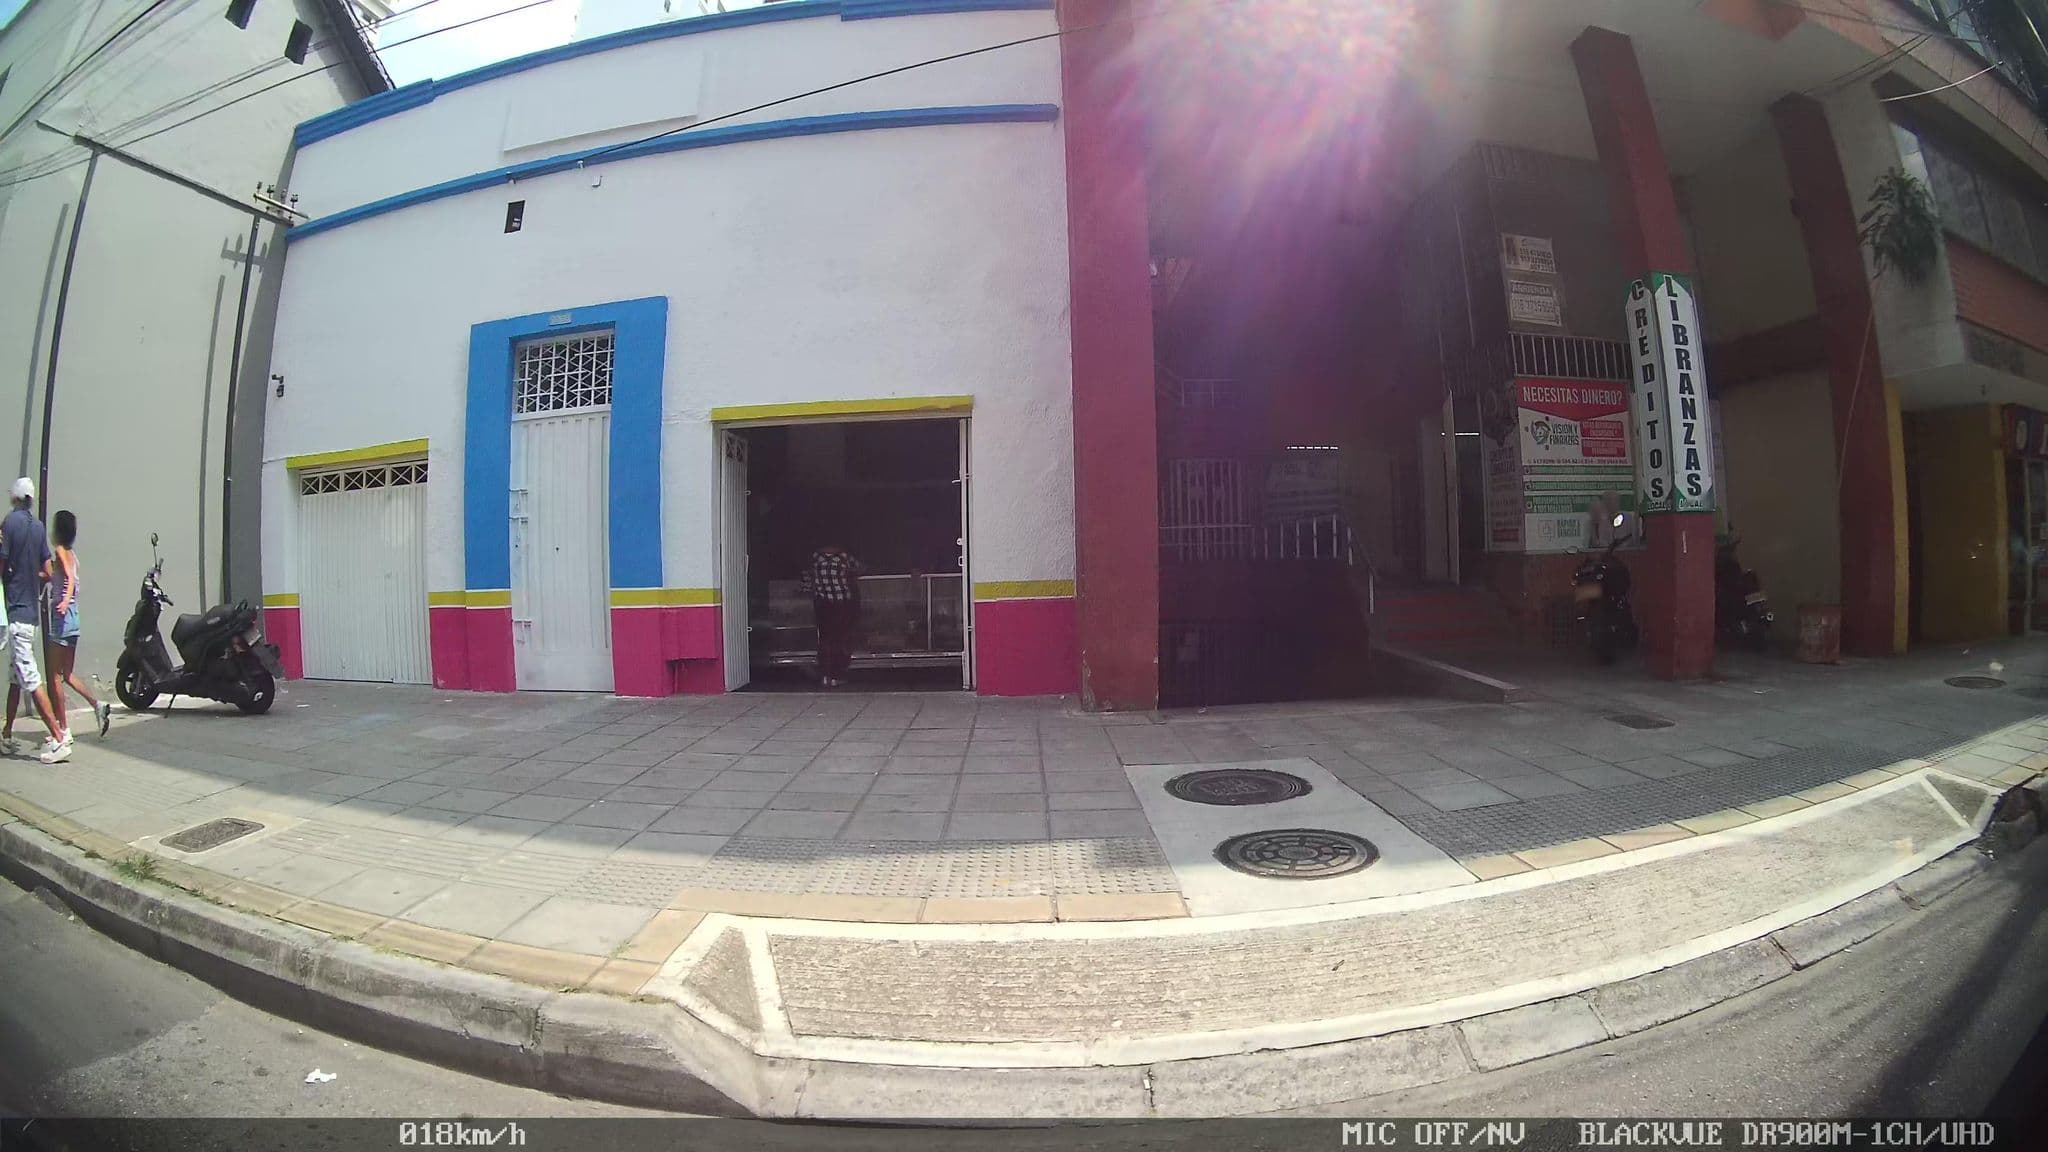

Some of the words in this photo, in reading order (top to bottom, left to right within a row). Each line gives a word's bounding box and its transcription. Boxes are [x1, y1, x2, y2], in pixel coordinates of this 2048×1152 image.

[1523, 386, 1579, 405] NECESITAS
[1581, 389, 1622, 406] DINERO?
[1631, 279, 1664, 498] CRÉDITOS
[1664, 274, 1702, 498] LIBRANZAS
